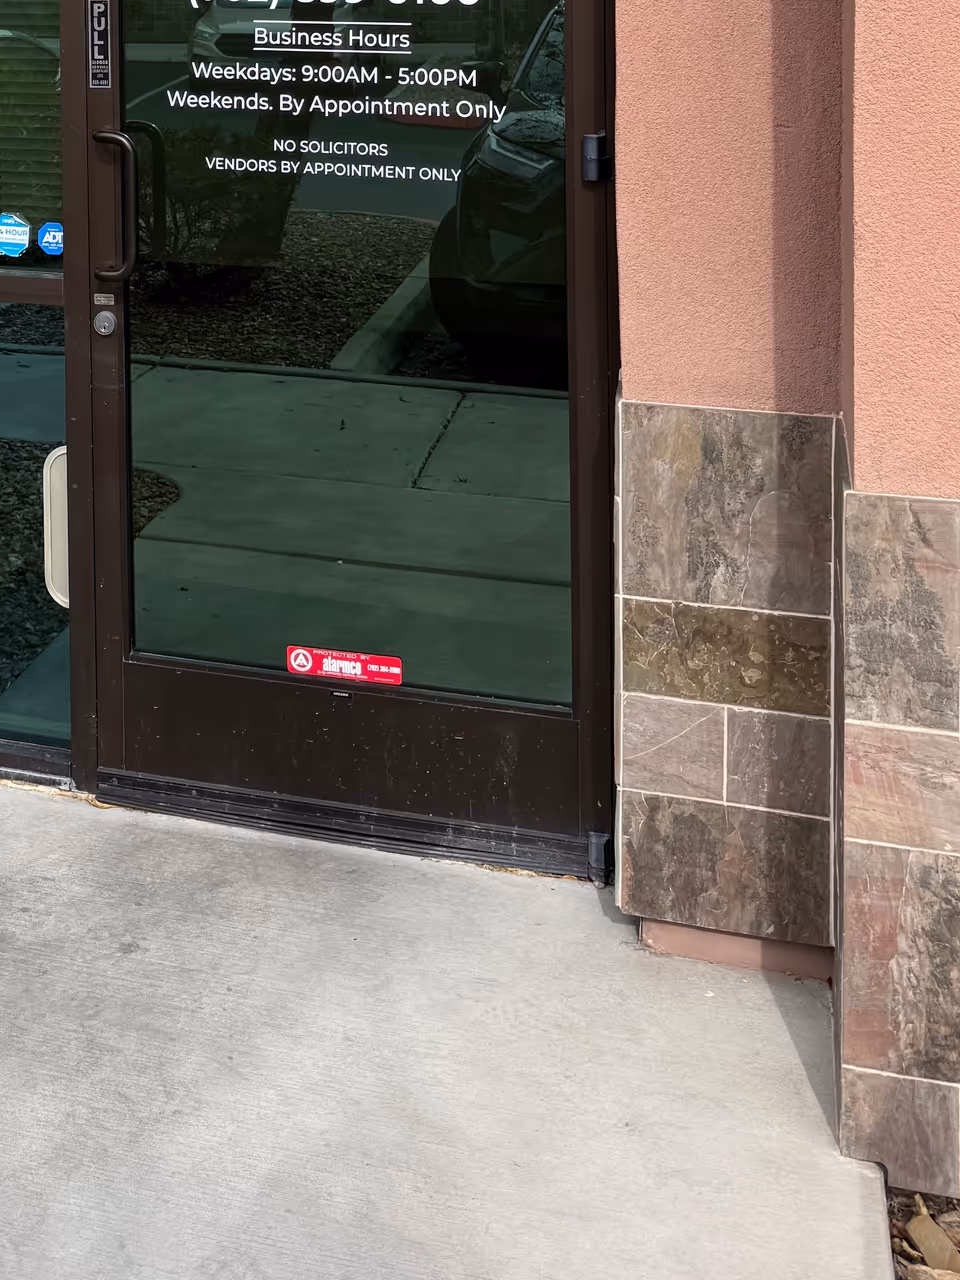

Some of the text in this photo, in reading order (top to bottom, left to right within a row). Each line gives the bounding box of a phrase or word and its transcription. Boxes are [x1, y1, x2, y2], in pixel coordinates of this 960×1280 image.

[93, 3, 105, 59] PULL
[253, 27, 410, 48] Business Hours
[191, 61, 297, 86] Weekdays:
[301, 64, 378, 84] 9:00AM
[397, 67, 477, 87] 5:00PM
[166, 90, 507, 123] Weekends. By Appointment Only
[273, 139, 389, 157] NO SOLICITORS
[205, 157, 462, 182] VENDORS BY APPOINTMENT ONLY
[5, 228, 28, 237] HOUR
[42, 231, 64, 243] ADT
[313, 650, 357, 659] PROTECTED
[322, 656, 362, 675] alarmco
